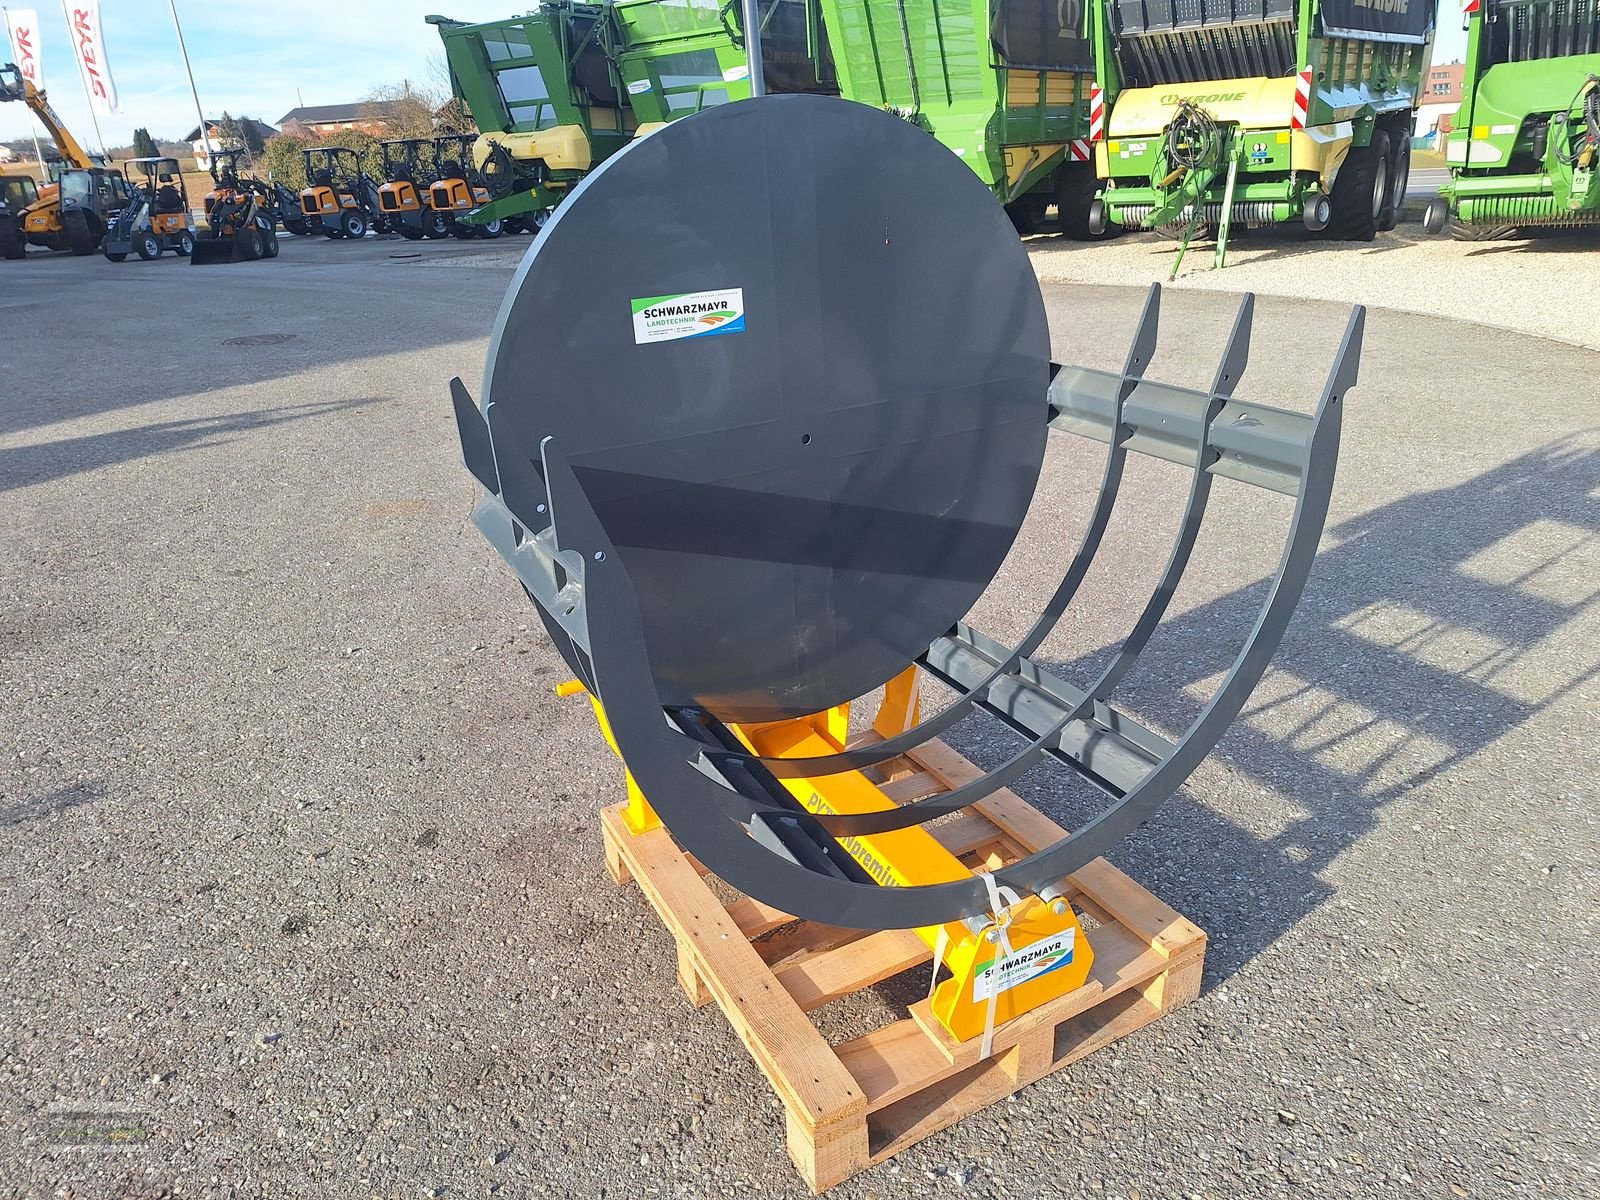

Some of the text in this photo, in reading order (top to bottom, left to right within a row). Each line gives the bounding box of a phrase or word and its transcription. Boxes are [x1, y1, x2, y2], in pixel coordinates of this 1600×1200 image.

[74, 9, 107, 99] STEYR
[643, 301, 729, 319] SCHWARZMAYR
[646, 316, 697, 328] LANDTECHNIK
